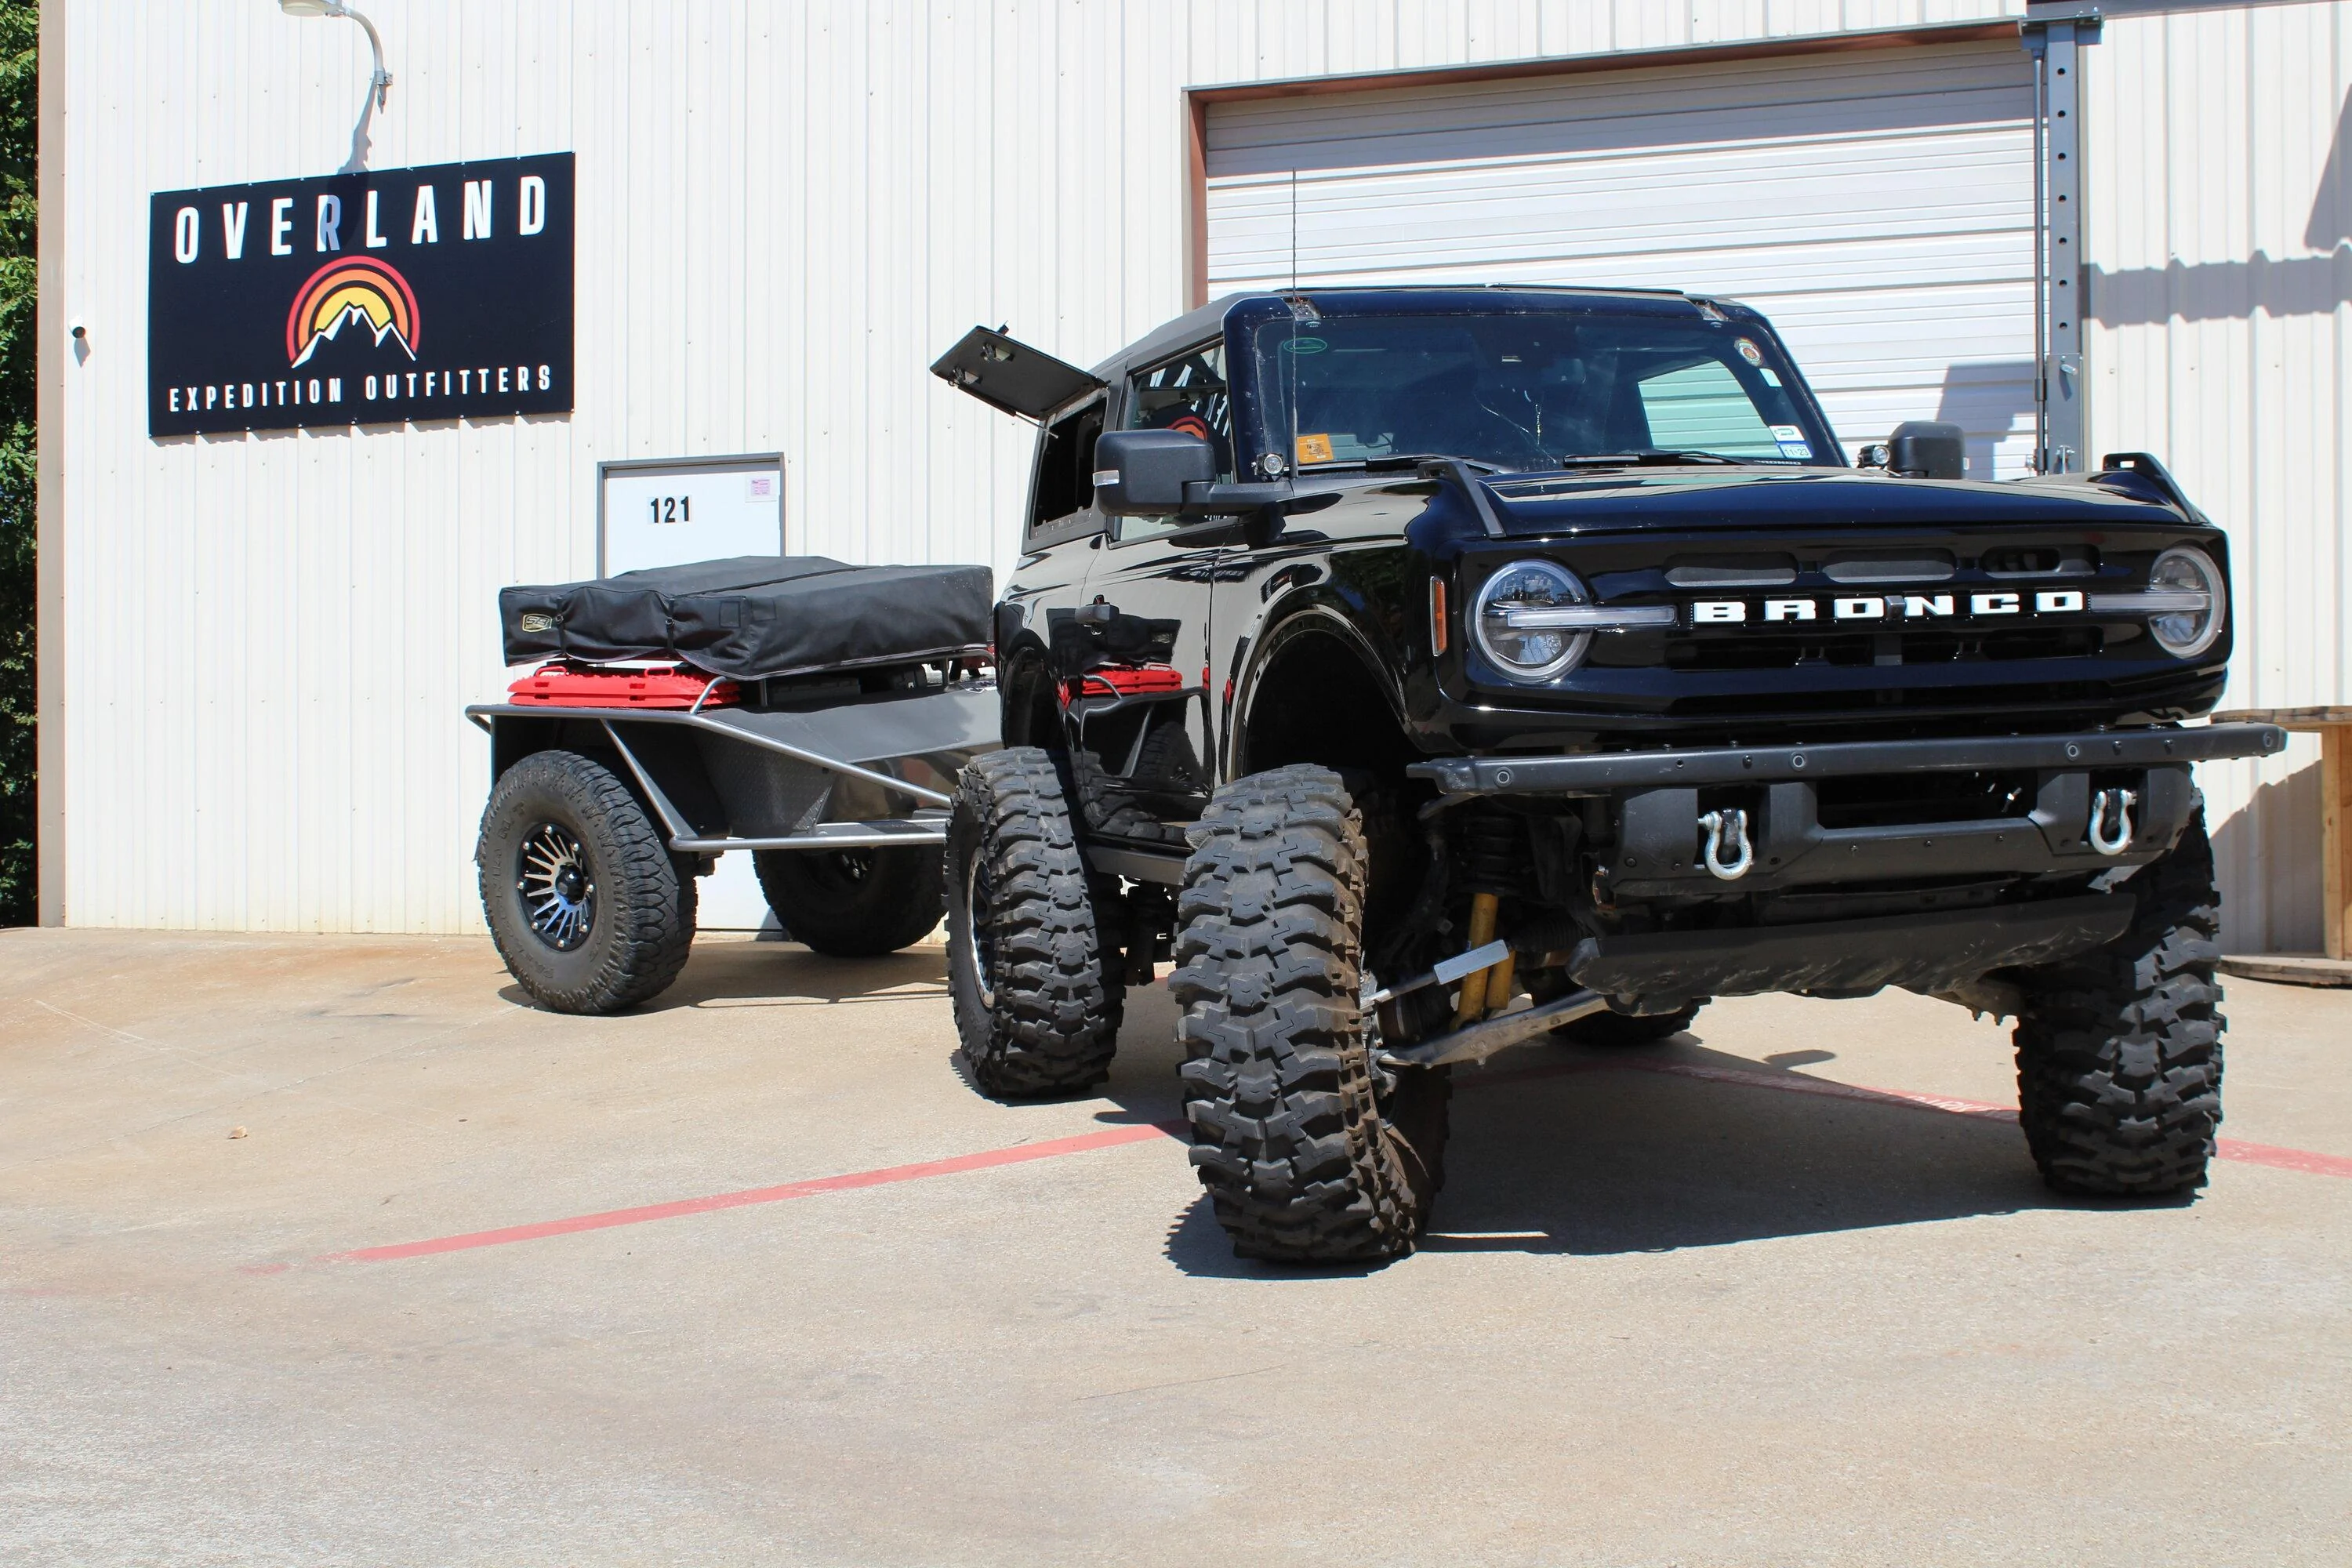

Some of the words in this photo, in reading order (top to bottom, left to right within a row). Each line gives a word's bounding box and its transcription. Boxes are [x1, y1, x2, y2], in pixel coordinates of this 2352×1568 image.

[174, 175, 546, 264] OVERLAND
[169, 377, 342, 413] EXPEDITION
[365, 365, 551, 401] OUTFITTERS
[650, 495, 690, 524] 121
[1693, 591, 2083, 623] BRONCO
